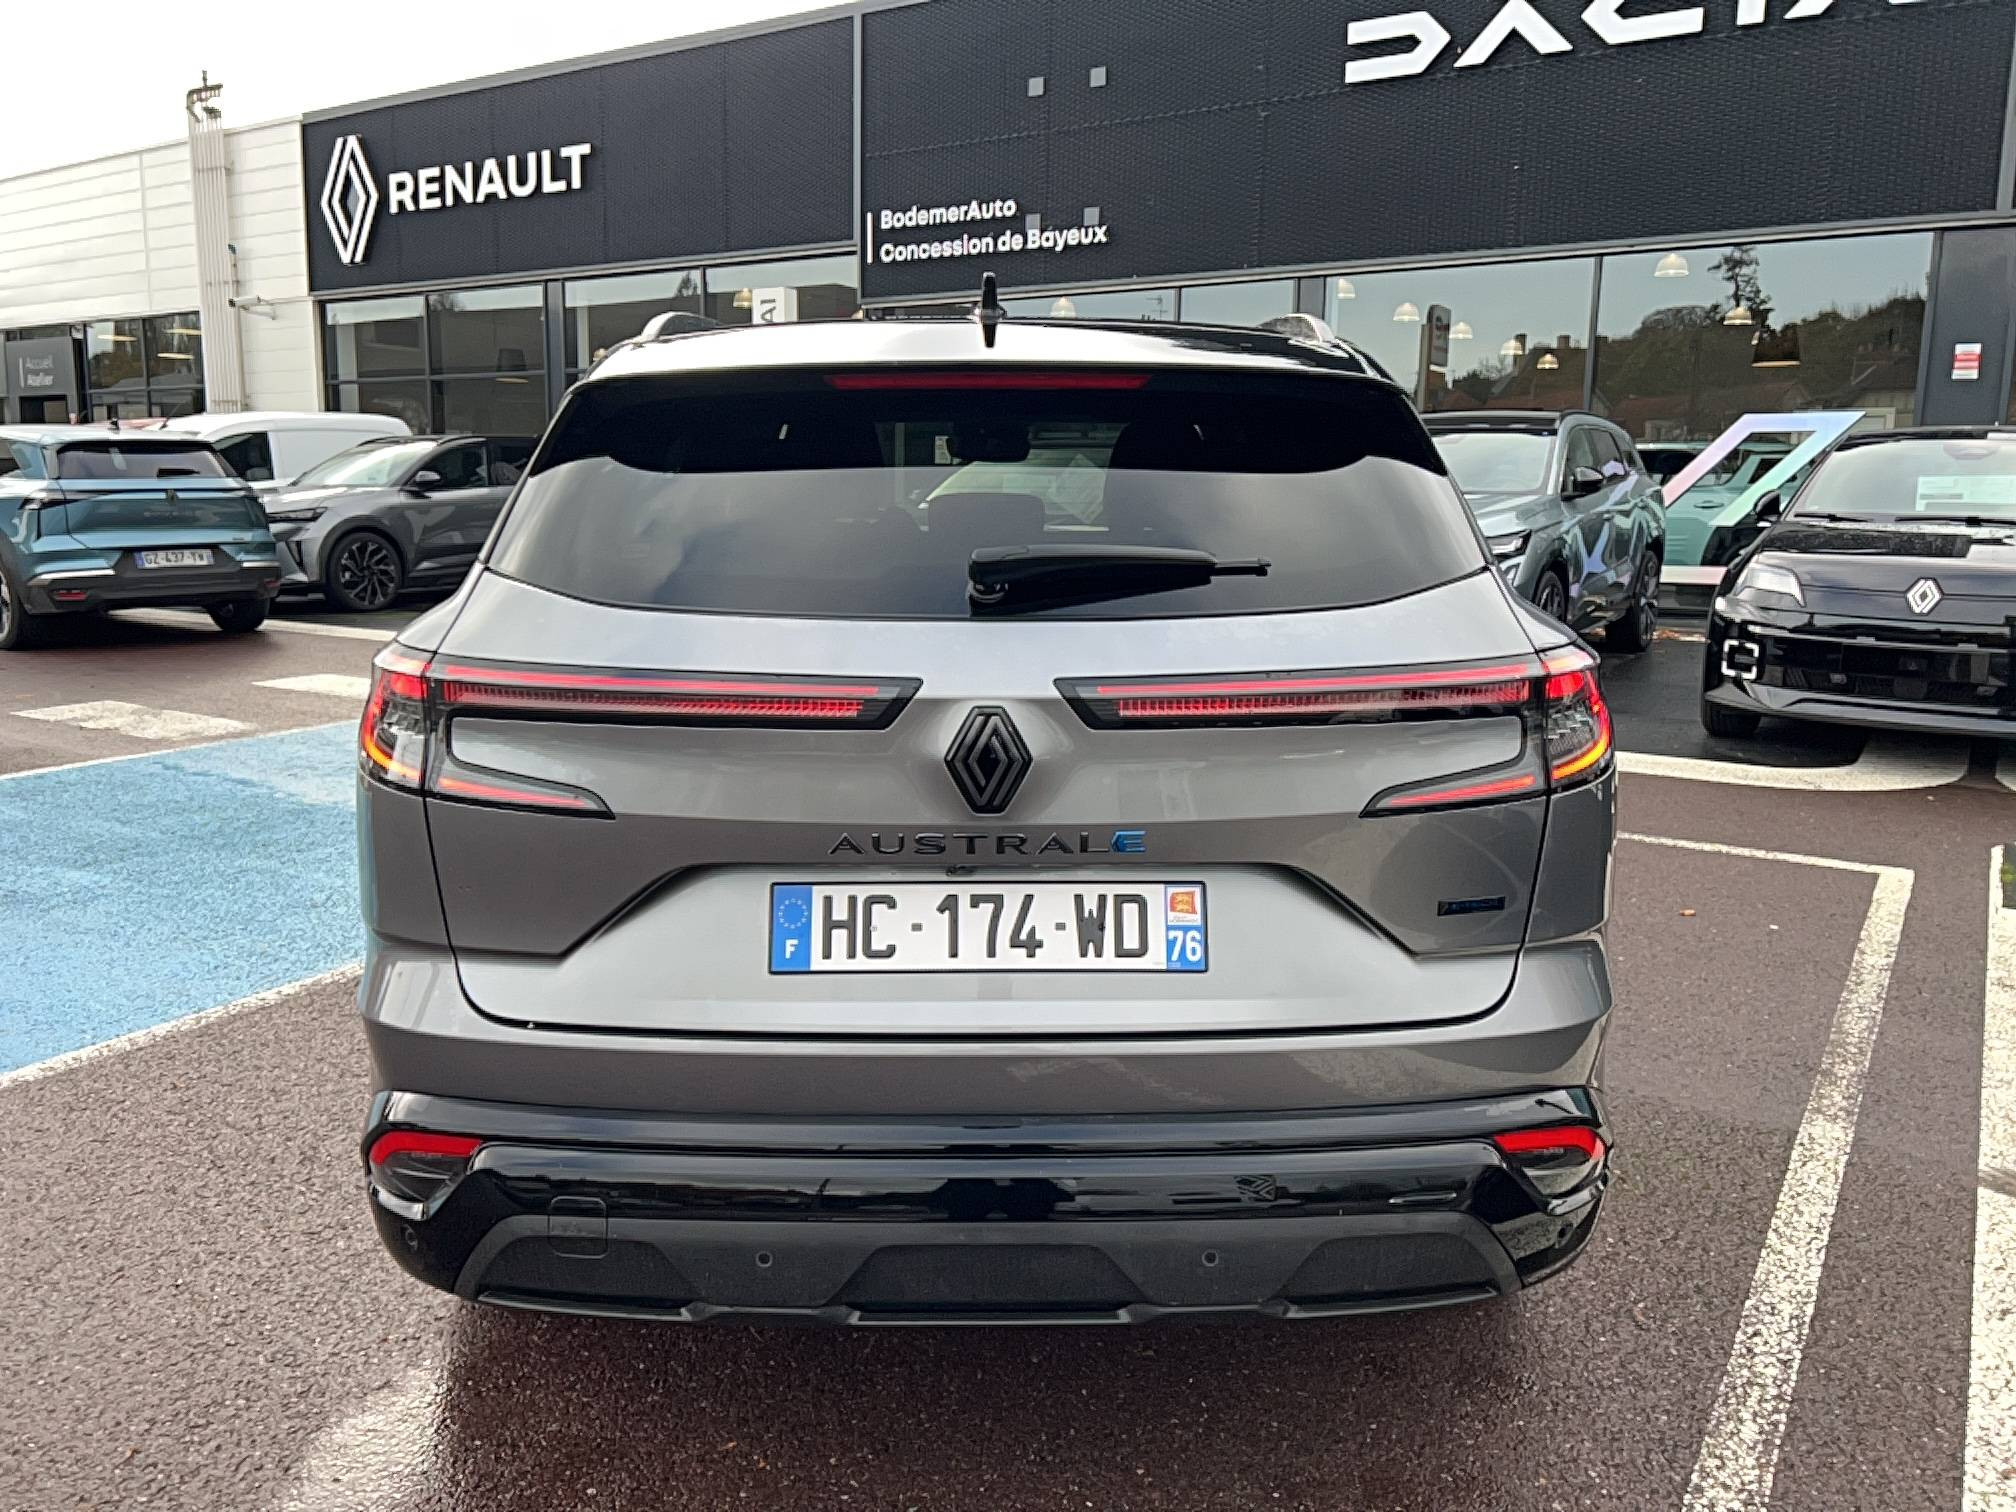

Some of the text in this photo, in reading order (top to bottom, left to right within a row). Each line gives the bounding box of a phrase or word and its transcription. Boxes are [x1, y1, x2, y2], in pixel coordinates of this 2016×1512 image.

[1344, 0, 1925, 84] DAC
[388, 143, 592, 215] RENAULT
[880, 199, 1017, 230] BodemerAuto
[880, 224, 1108, 263] Concession de Bayeux
[822, 893, 1149, 960] HC-174-WD
[1168, 930, 1202, 962] 76
[785, 939, 799, 959] F
